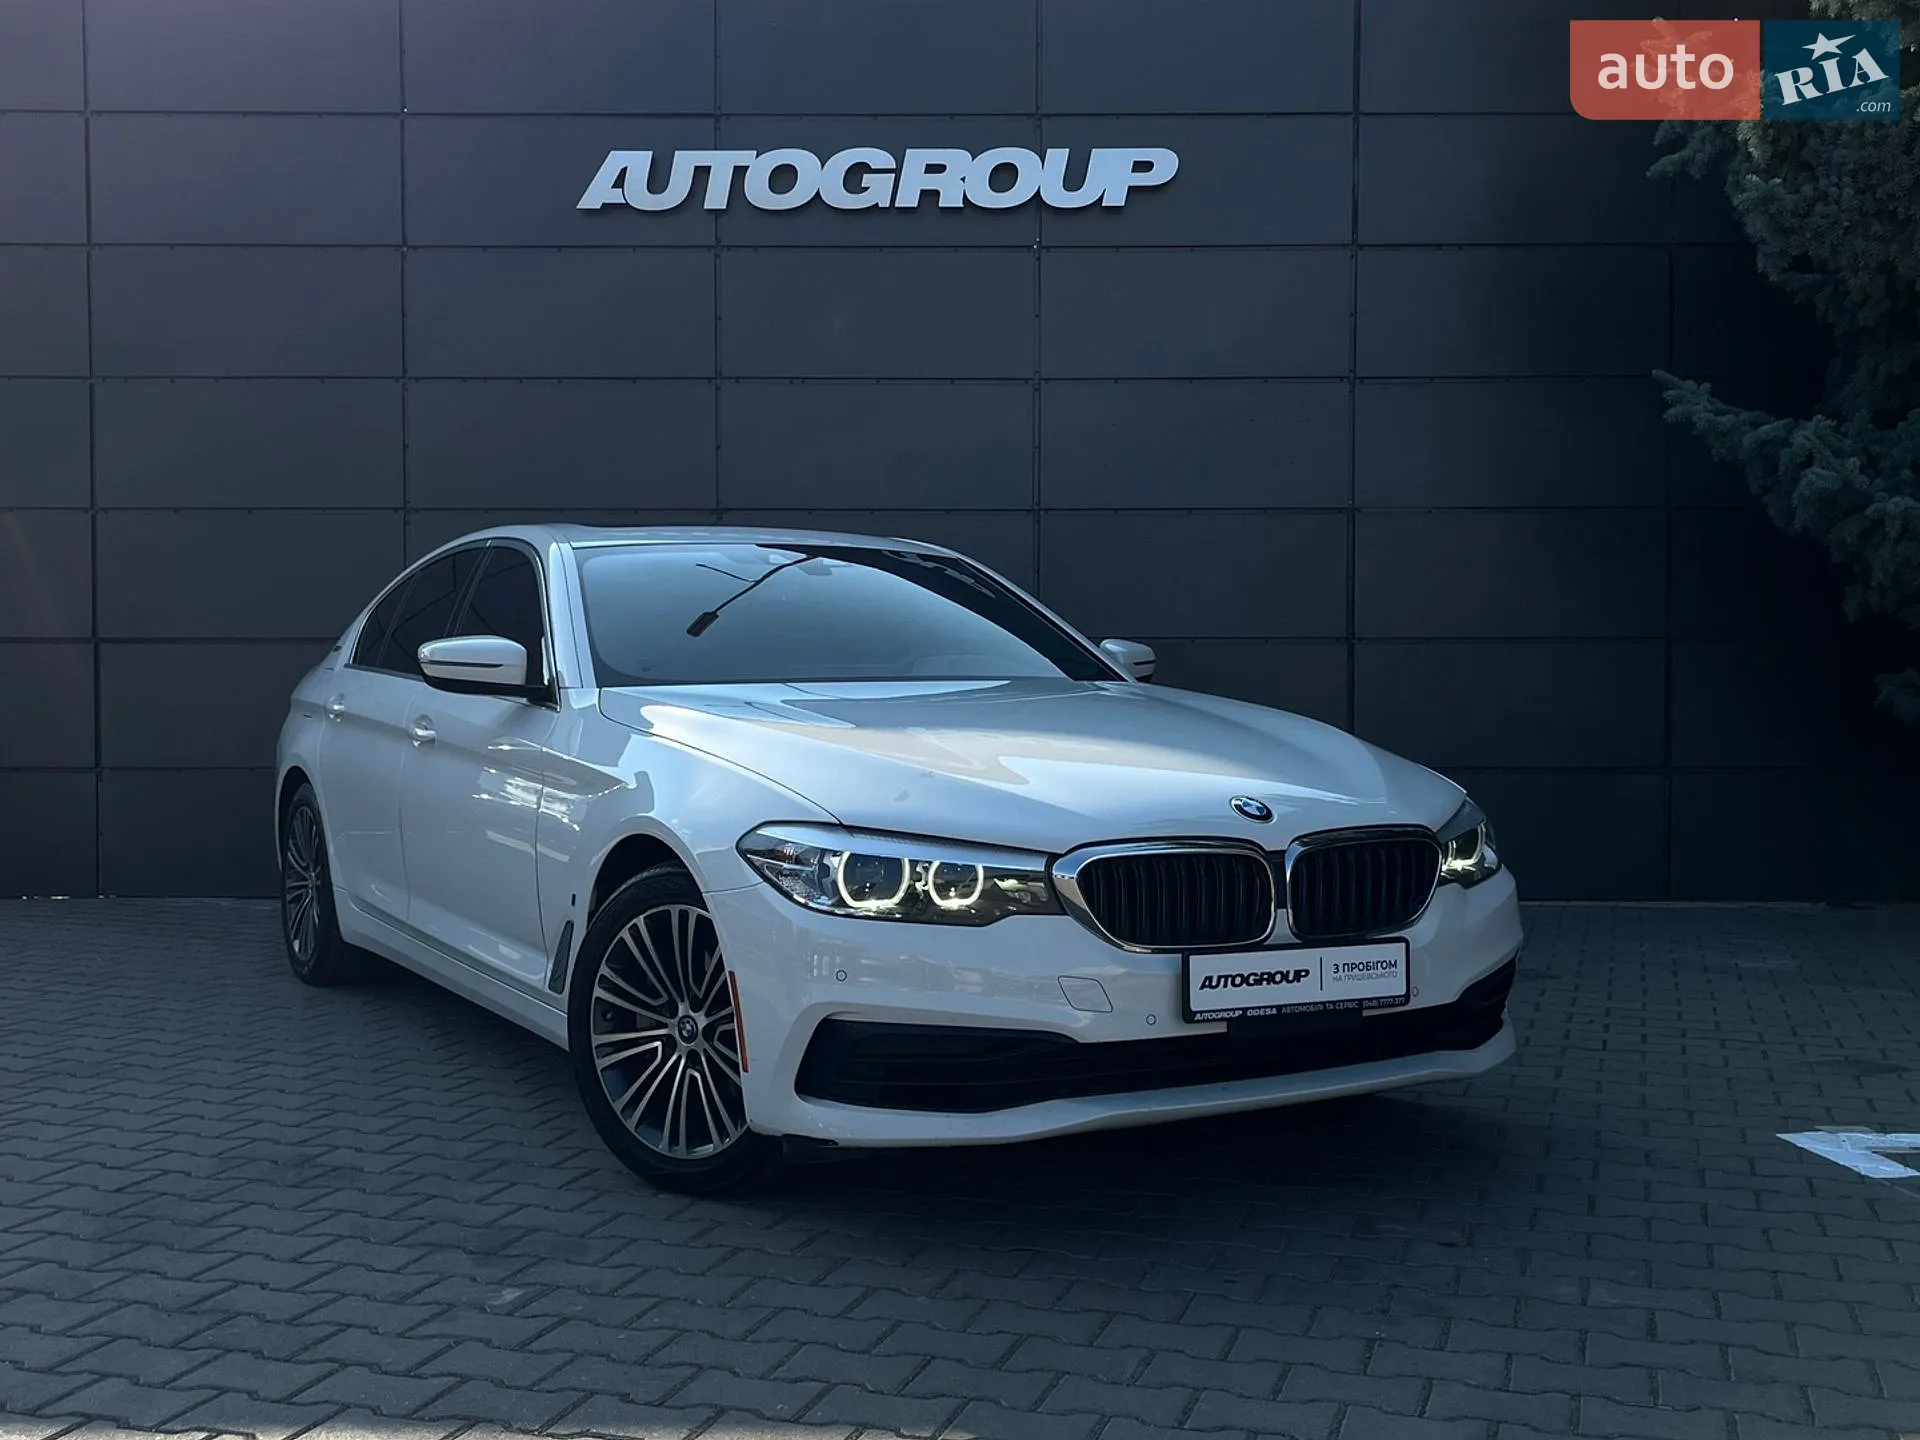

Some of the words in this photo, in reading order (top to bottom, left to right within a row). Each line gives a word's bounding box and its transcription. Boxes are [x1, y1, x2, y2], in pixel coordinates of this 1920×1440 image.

[576, 147, 1180, 211] AUTOGROUP
[1342, 960, 1398, 973] ПРОБІГОМ
[1199, 969, 1310, 991] AUTOGROUP
[1194, 1010, 1242, 1020] AUTOGROUP
[1247, 1008, 1277, 1016] ODESA
